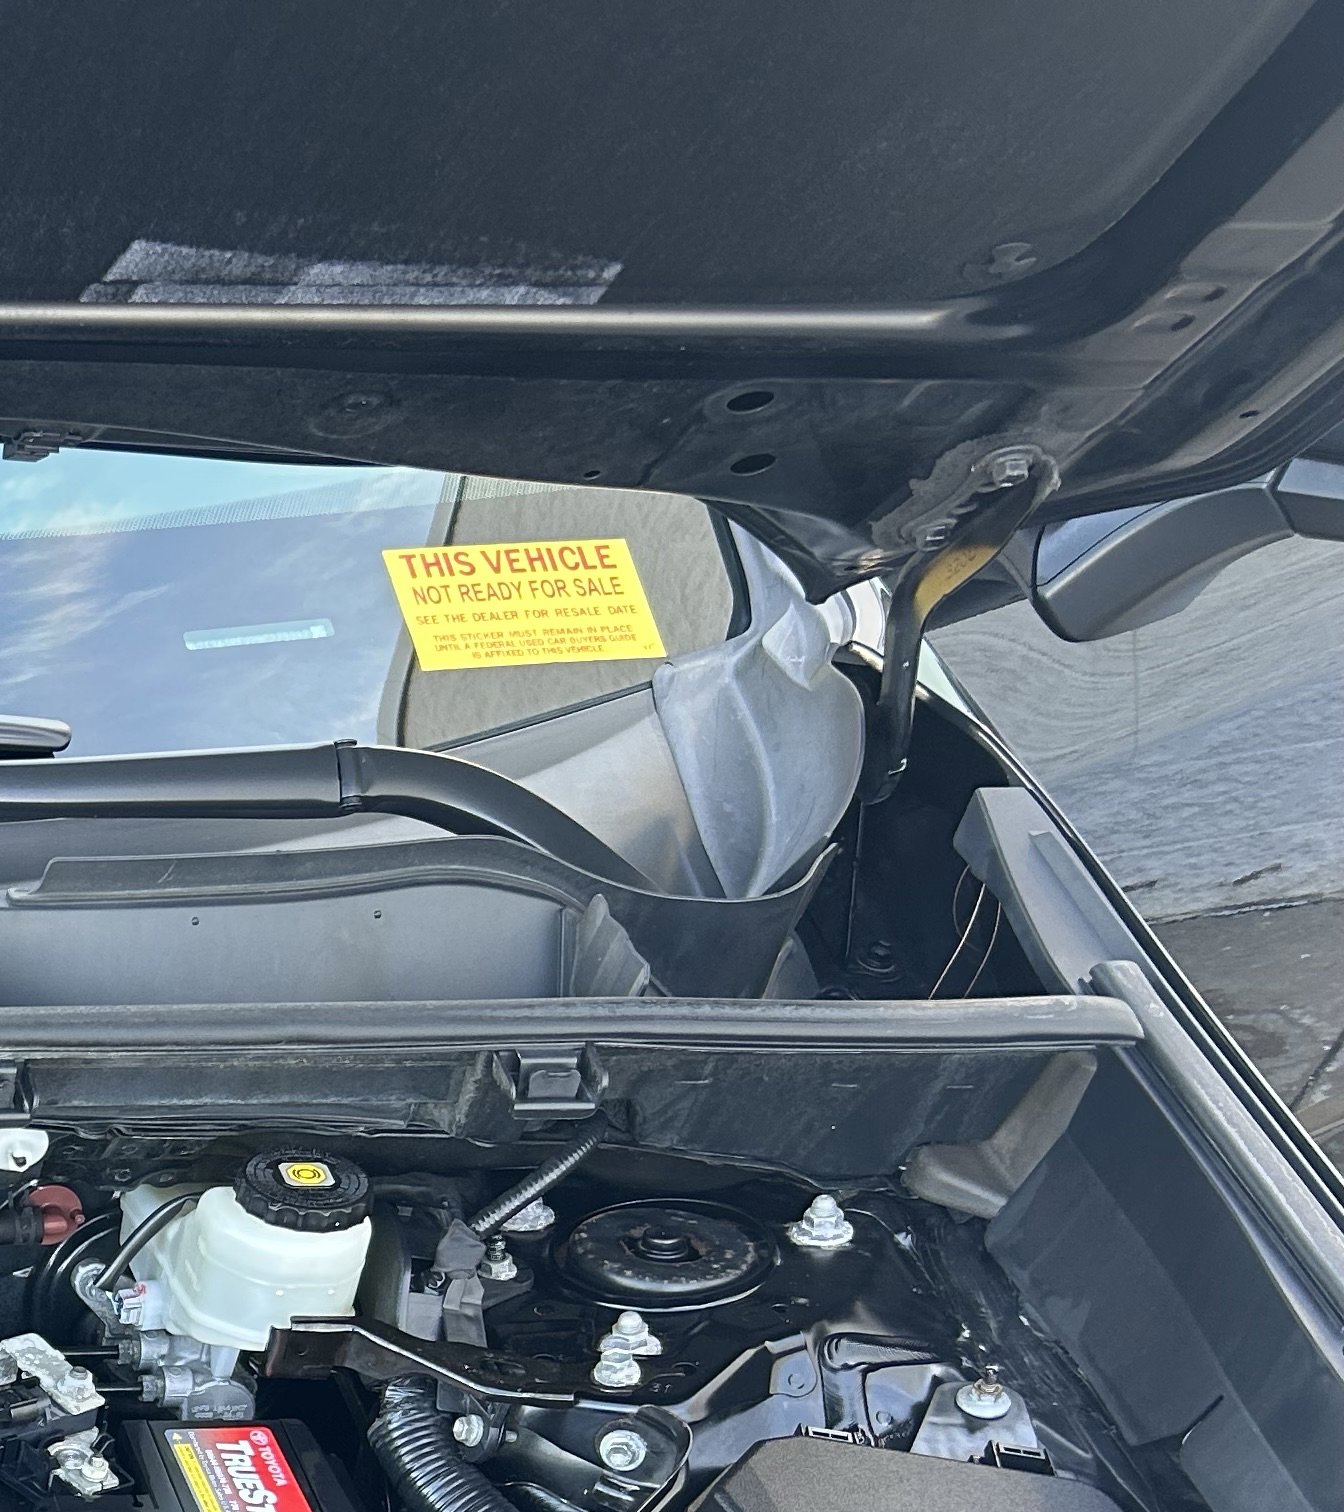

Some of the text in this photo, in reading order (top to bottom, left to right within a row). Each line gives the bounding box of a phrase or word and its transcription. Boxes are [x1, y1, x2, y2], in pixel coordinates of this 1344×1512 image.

[398, 545, 617, 578] THIS VEHICLE
[412, 576, 624, 606] NOT READY FOR SALE
[416, 604, 638, 625] SEE THE DEALER FOR RESALE DATE
[433, 624, 633, 642] THIS STICKER MUST REMAIN IN PLACE
[435, 643, 461, 652] UNTIL
[474, 640, 516, 650] FEDERAL
[519, 638, 544, 646] USED
[547, 637, 567, 645] CAR
[609, 633, 637, 642] GUIDE
[485, 649, 524, 658] AFFIXED
[527, 648, 540, 656] TO
[542, 646, 564, 655] THIS
[566, 645, 605, 653] VEHICLE
[257, 1445, 289, 1487] TOYOTA
